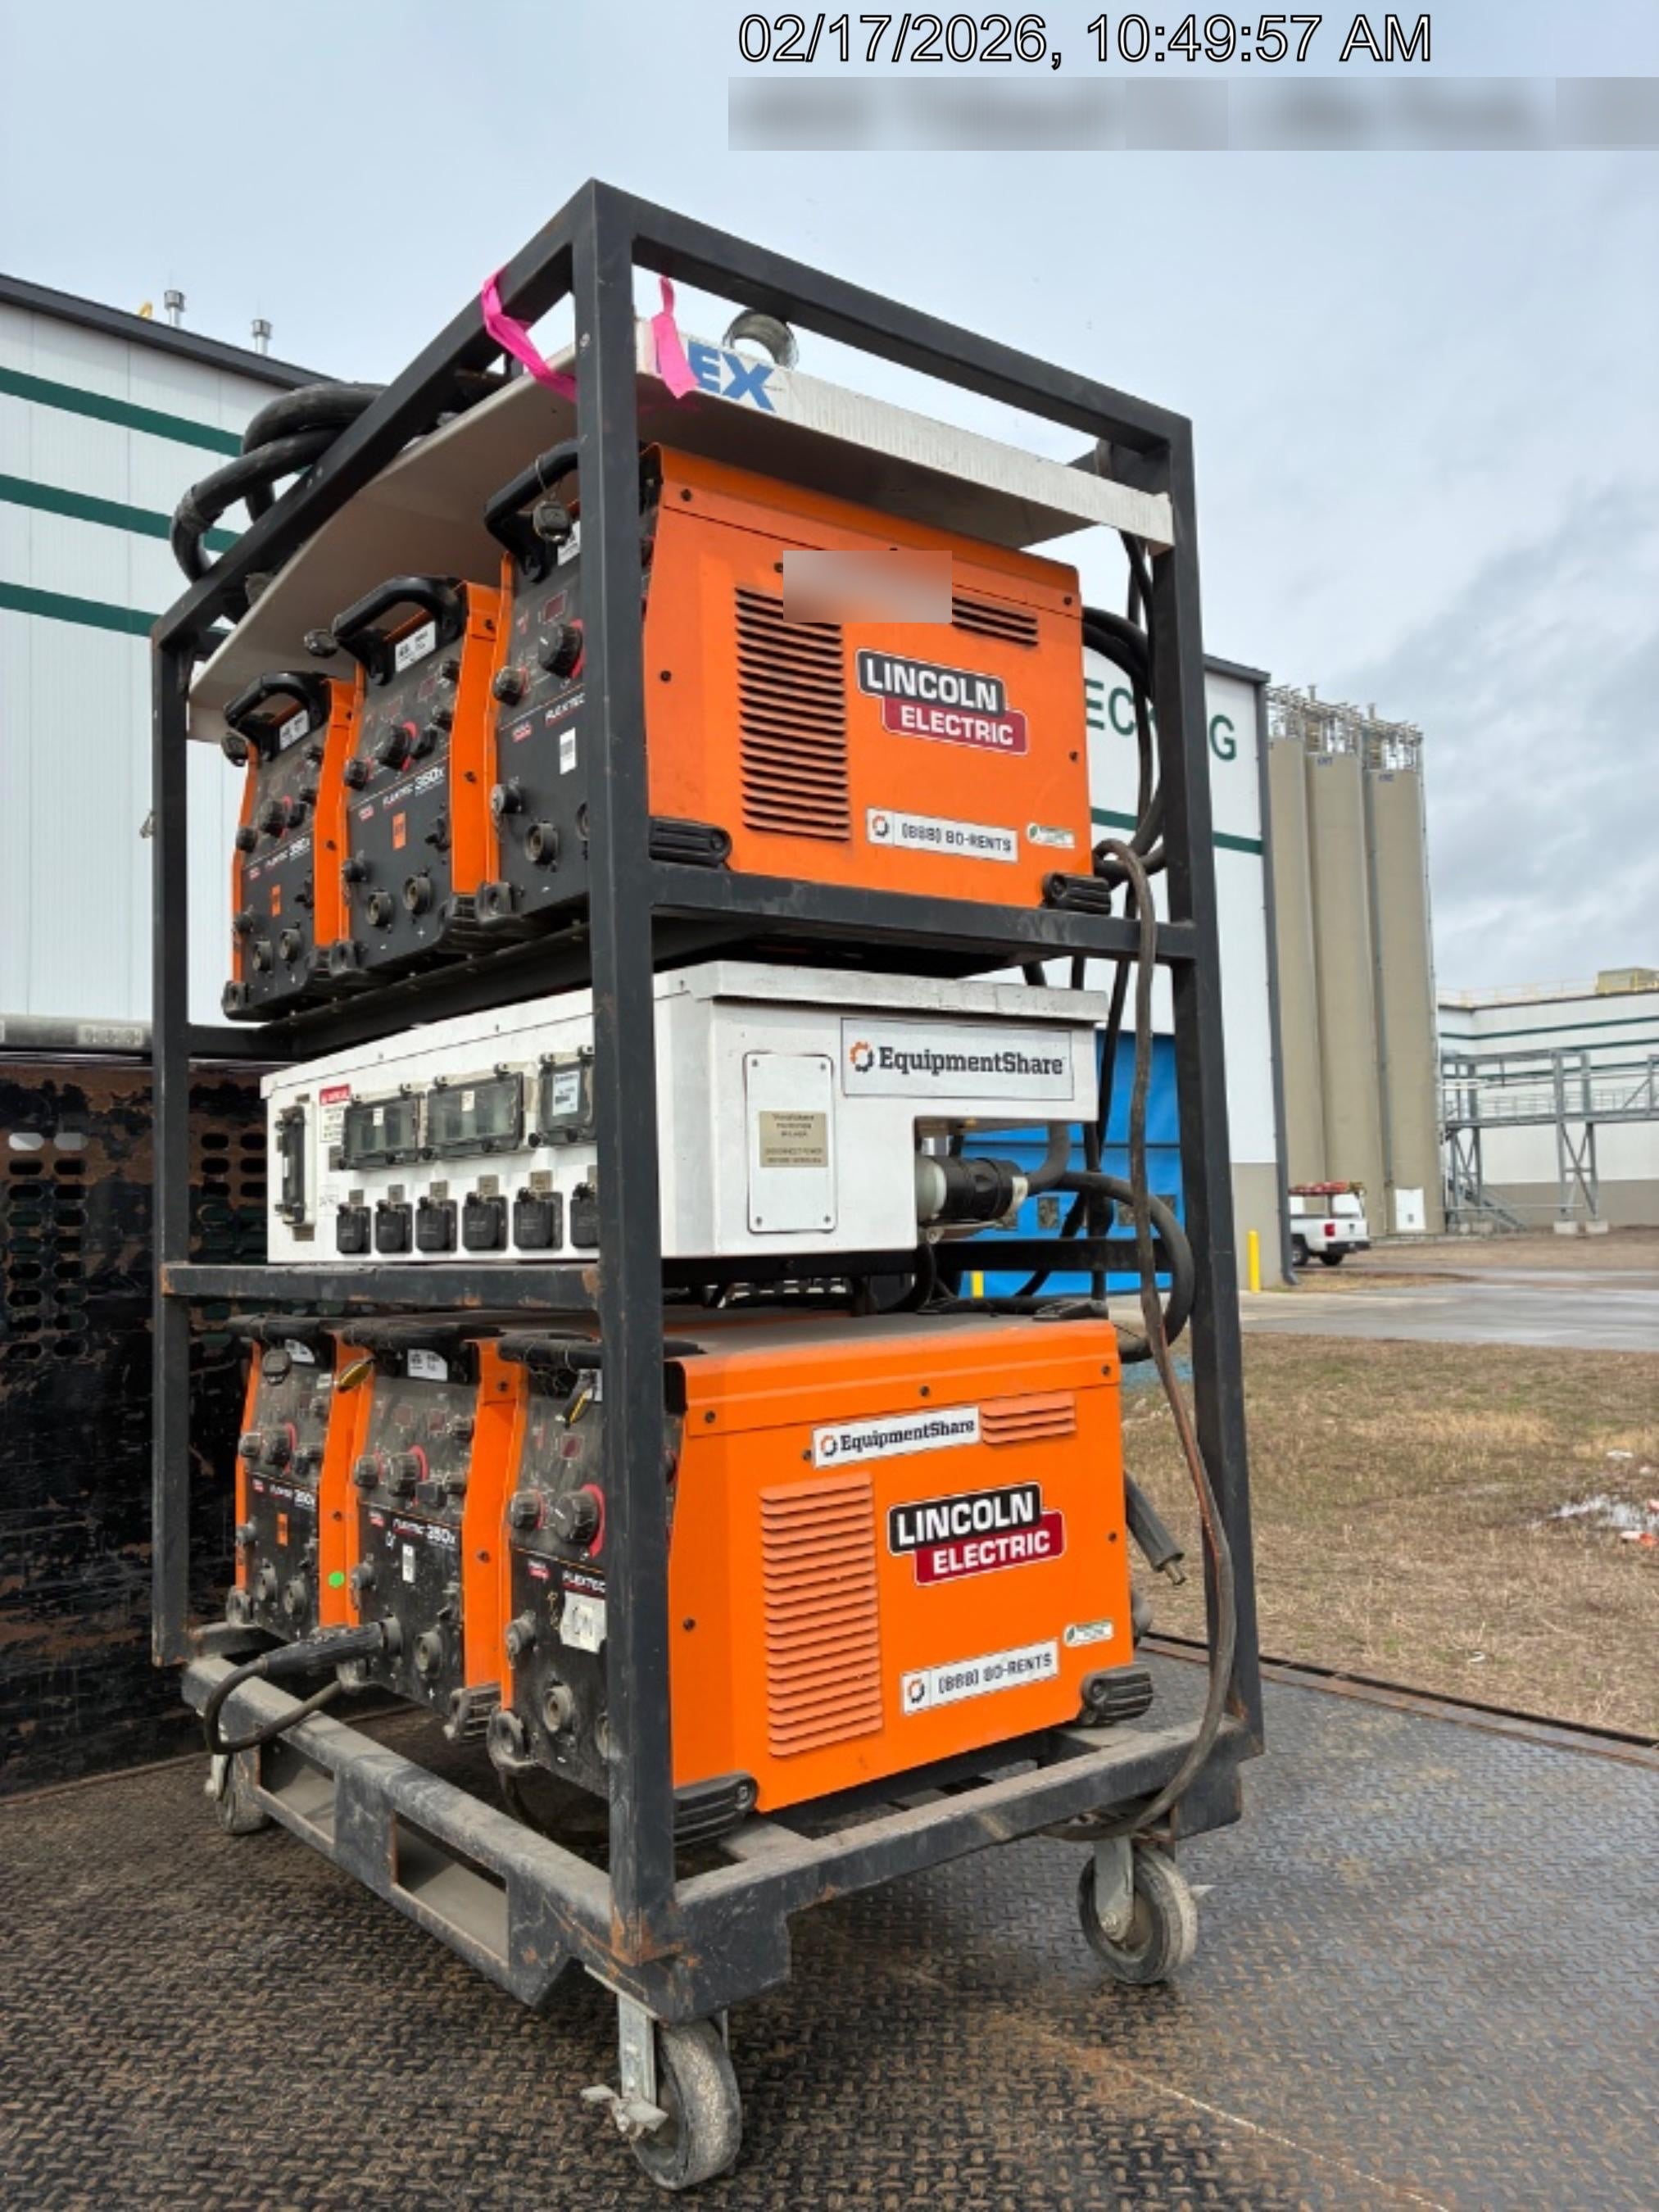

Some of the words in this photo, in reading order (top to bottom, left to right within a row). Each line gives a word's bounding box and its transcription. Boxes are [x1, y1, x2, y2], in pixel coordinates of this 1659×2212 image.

[865, 658, 998, 712] LINCOLN
[900, 705, 1013, 745] ELECTRIC
[878, 1045, 1063, 1077] EquipmentShare
[840, 1420, 975, 1453] EquipmentShare
[897, 1491, 1034, 1546] LINCOLN
[932, 1530, 1050, 1575] ELECTRIC
